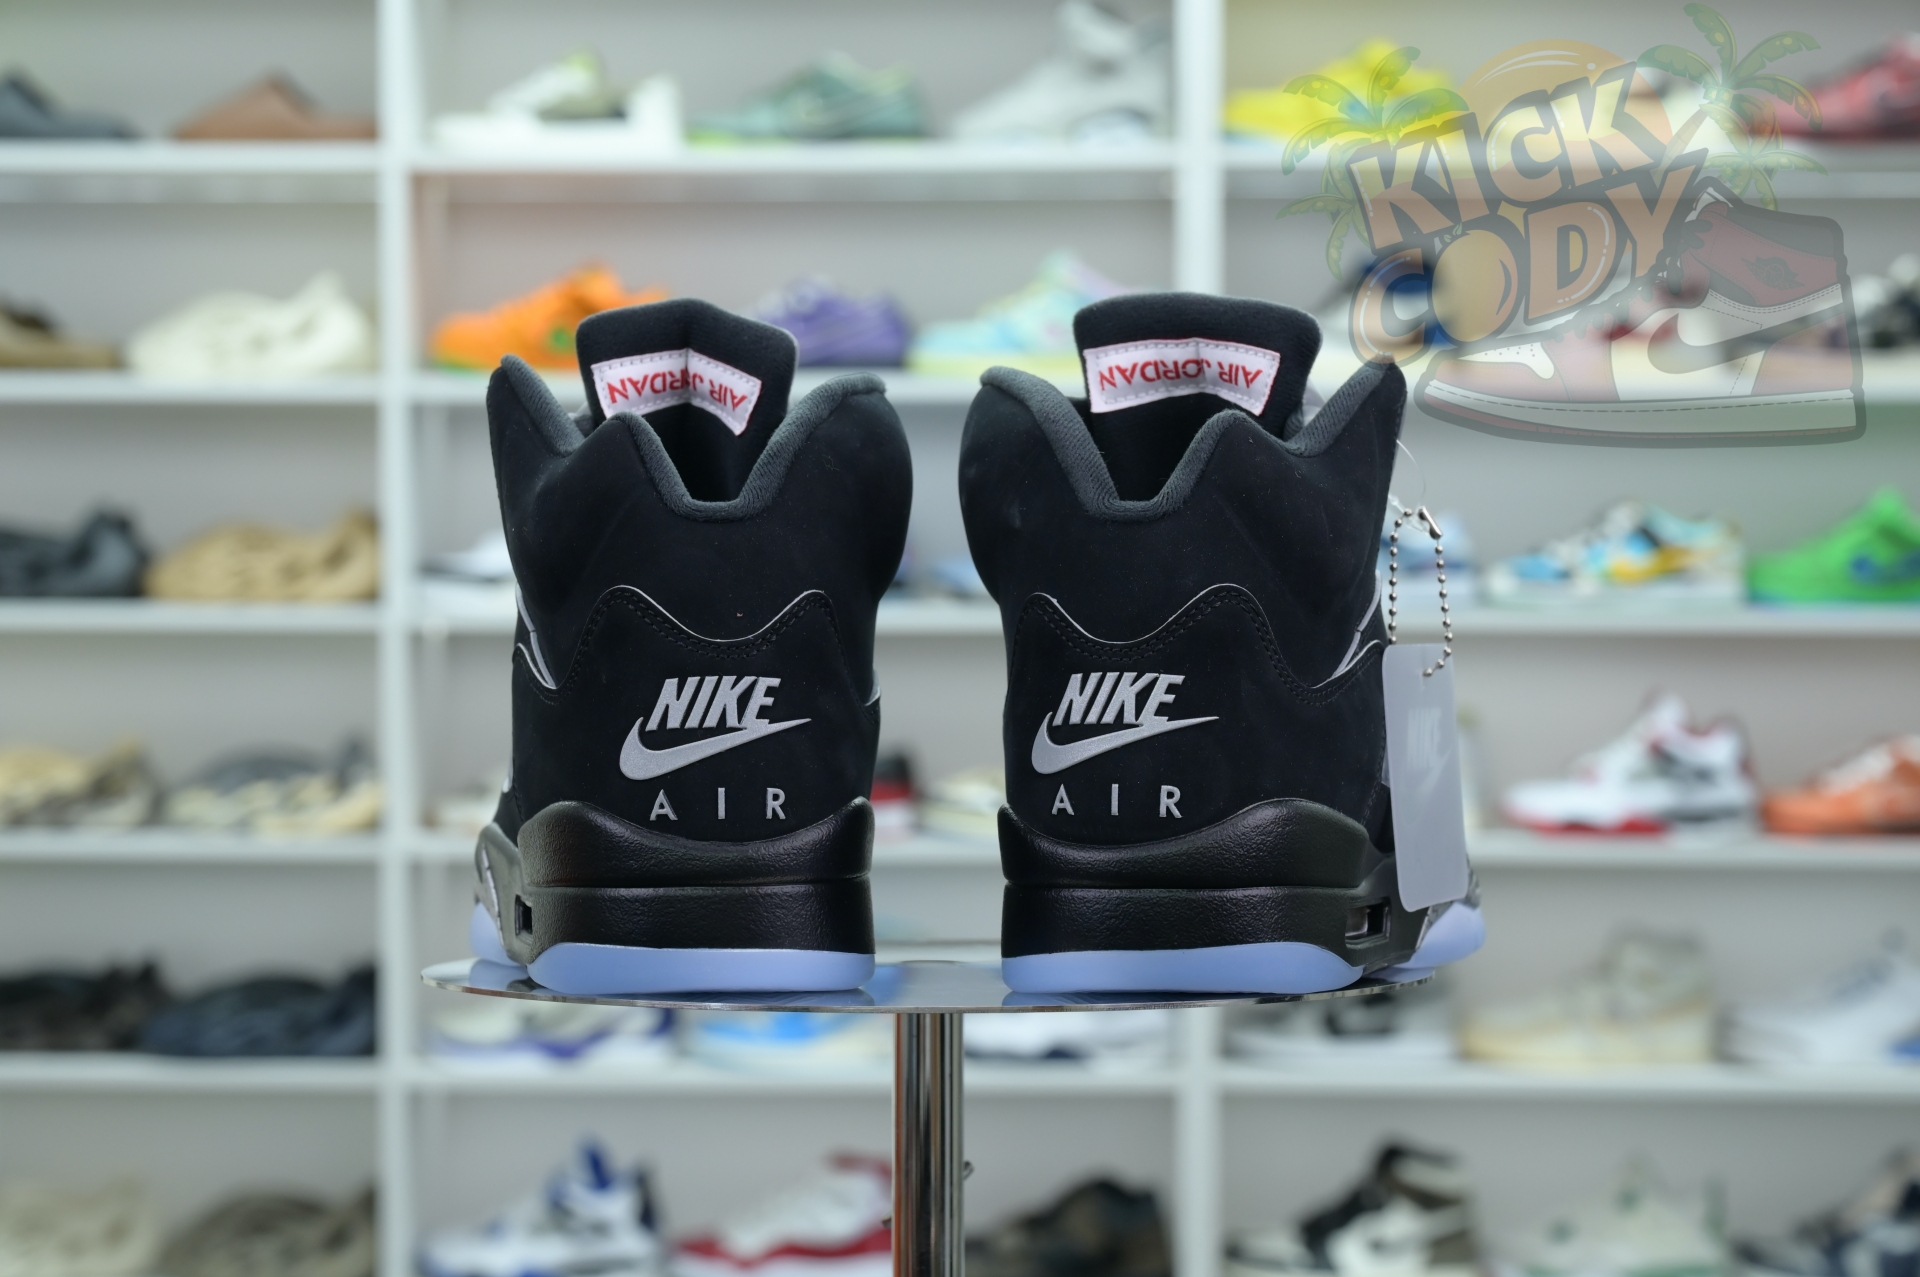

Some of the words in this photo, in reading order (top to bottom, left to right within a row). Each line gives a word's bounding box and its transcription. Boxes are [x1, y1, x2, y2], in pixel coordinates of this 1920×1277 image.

[606, 368, 705, 404] JRDAN
[1217, 361, 1264, 389] AIR
[709, 378, 748, 412] AIR
[645, 675, 782, 731] NIKE
[1052, 671, 1186, 727] NIKE
[649, 787, 786, 821] AIR
[1051, 783, 1183, 819] AIR
